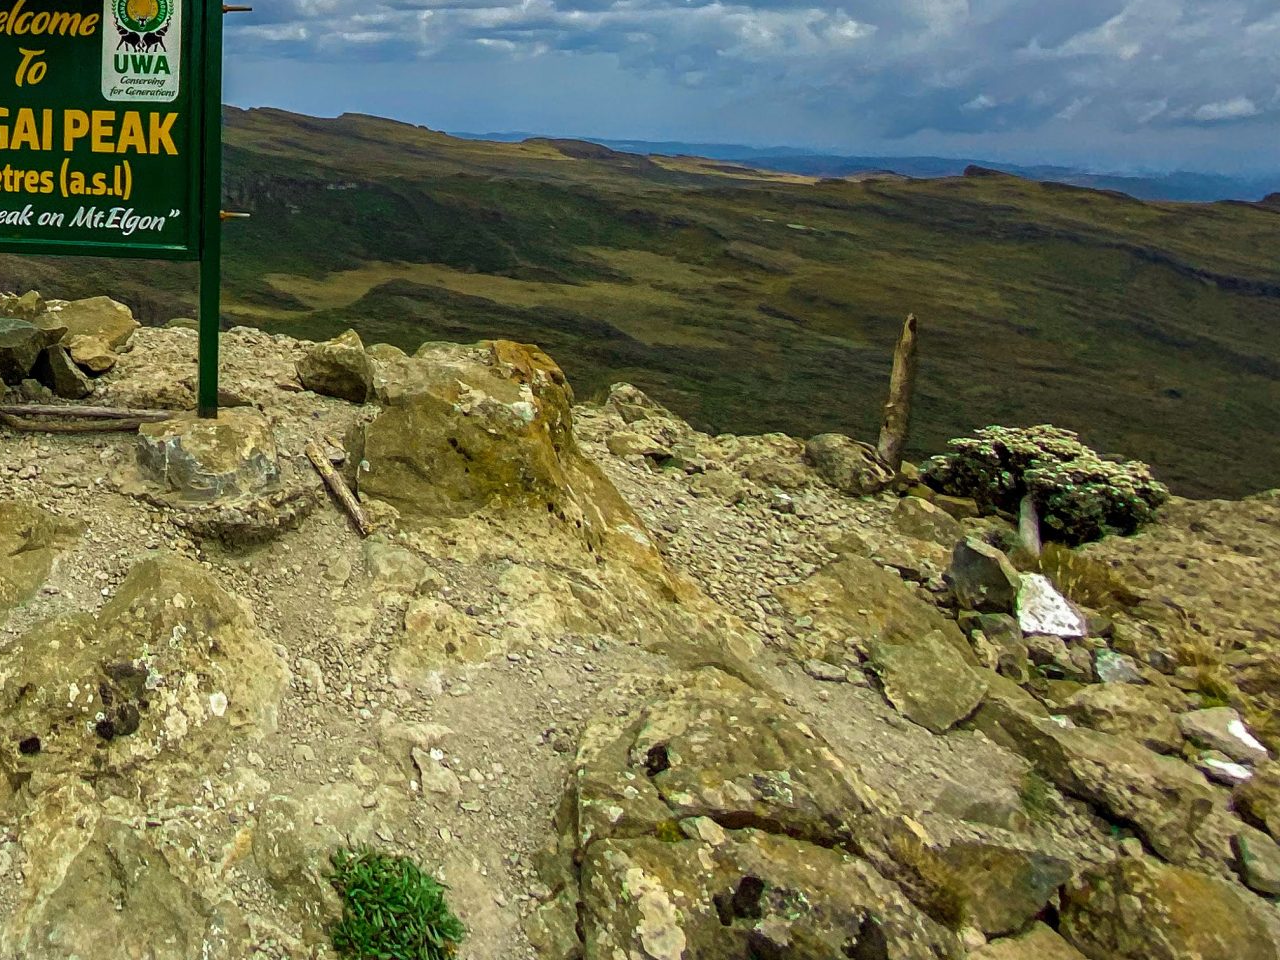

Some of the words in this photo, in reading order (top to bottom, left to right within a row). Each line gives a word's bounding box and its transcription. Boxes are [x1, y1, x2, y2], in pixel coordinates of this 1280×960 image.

[14, 47, 47, 87] To
[114, 54, 170, 74] UWA
[109, 86, 124, 97] for
[125, 86, 175, 97] Generations
[120, 76, 166, 87] Conserving
[64, 109, 179, 155] PEAK
[60, 158, 132, 200] (a.s.l)
[37, 213, 65, 227] on
